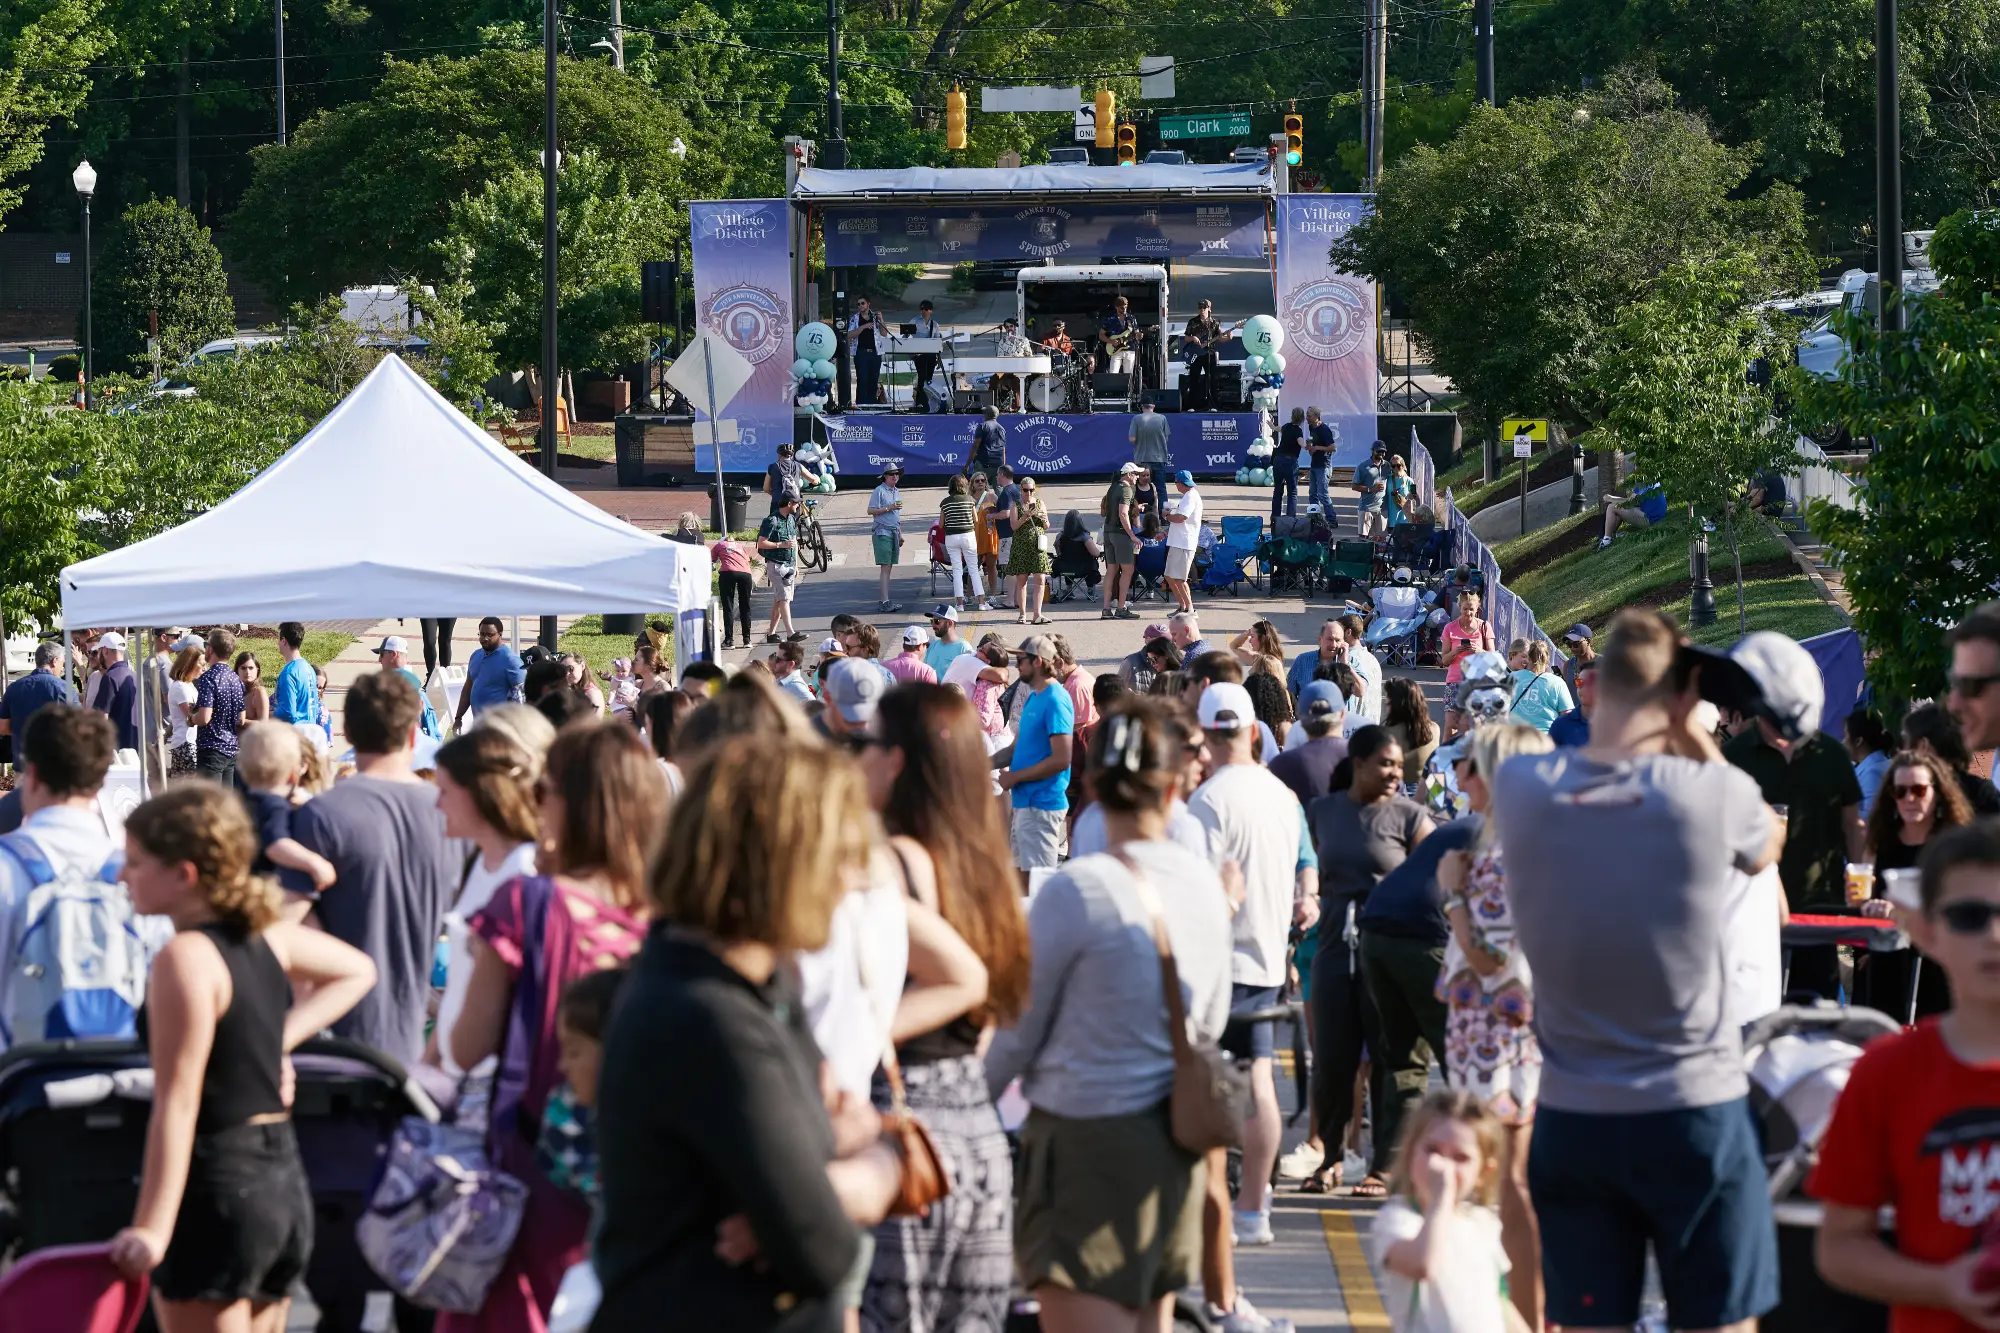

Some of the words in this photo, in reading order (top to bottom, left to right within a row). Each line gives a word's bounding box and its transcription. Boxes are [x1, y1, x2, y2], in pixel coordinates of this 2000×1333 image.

[1160, 129, 1179, 139] 1900
[1187, 119, 1220, 134] Clark
[1231, 113, 1247, 122] AVE
[1229, 125, 1250, 135] 2000
[1079, 129, 1097, 138] ONL
[716, 214, 764, 226] Village
[1014, 206, 1044, 221] THANKS
[1046, 206, 1055, 214] TO
[1056, 208, 1072, 220] OUR
[1302, 207, 1351, 220] Village
[908, 221, 927, 231] city
[716, 227, 767, 239] District
[1135, 236, 1170, 245] Regency
[1200, 237, 1229, 251] york
[1018, 239, 1071, 257] SPONSORS
[732, 292, 769, 307] ANNIVERSARY
[1315, 286, 1352, 301] ANNIVERSARY
[808, 332, 824, 345] 75
[1256, 331, 1272, 343] 75
[1299, 337, 1356, 357] CELEBRATION
[1014, 416, 1045, 433] THANKS
[1047, 416, 1057, 426] TO
[1057, 419, 1073, 434] OUR
[904, 433, 924, 441] city
[1037, 436, 1052, 447] 75
[938, 452, 959, 464] MP
[1017, 454, 1072, 472] SPONSORS
[1205, 451, 1236, 467] york
